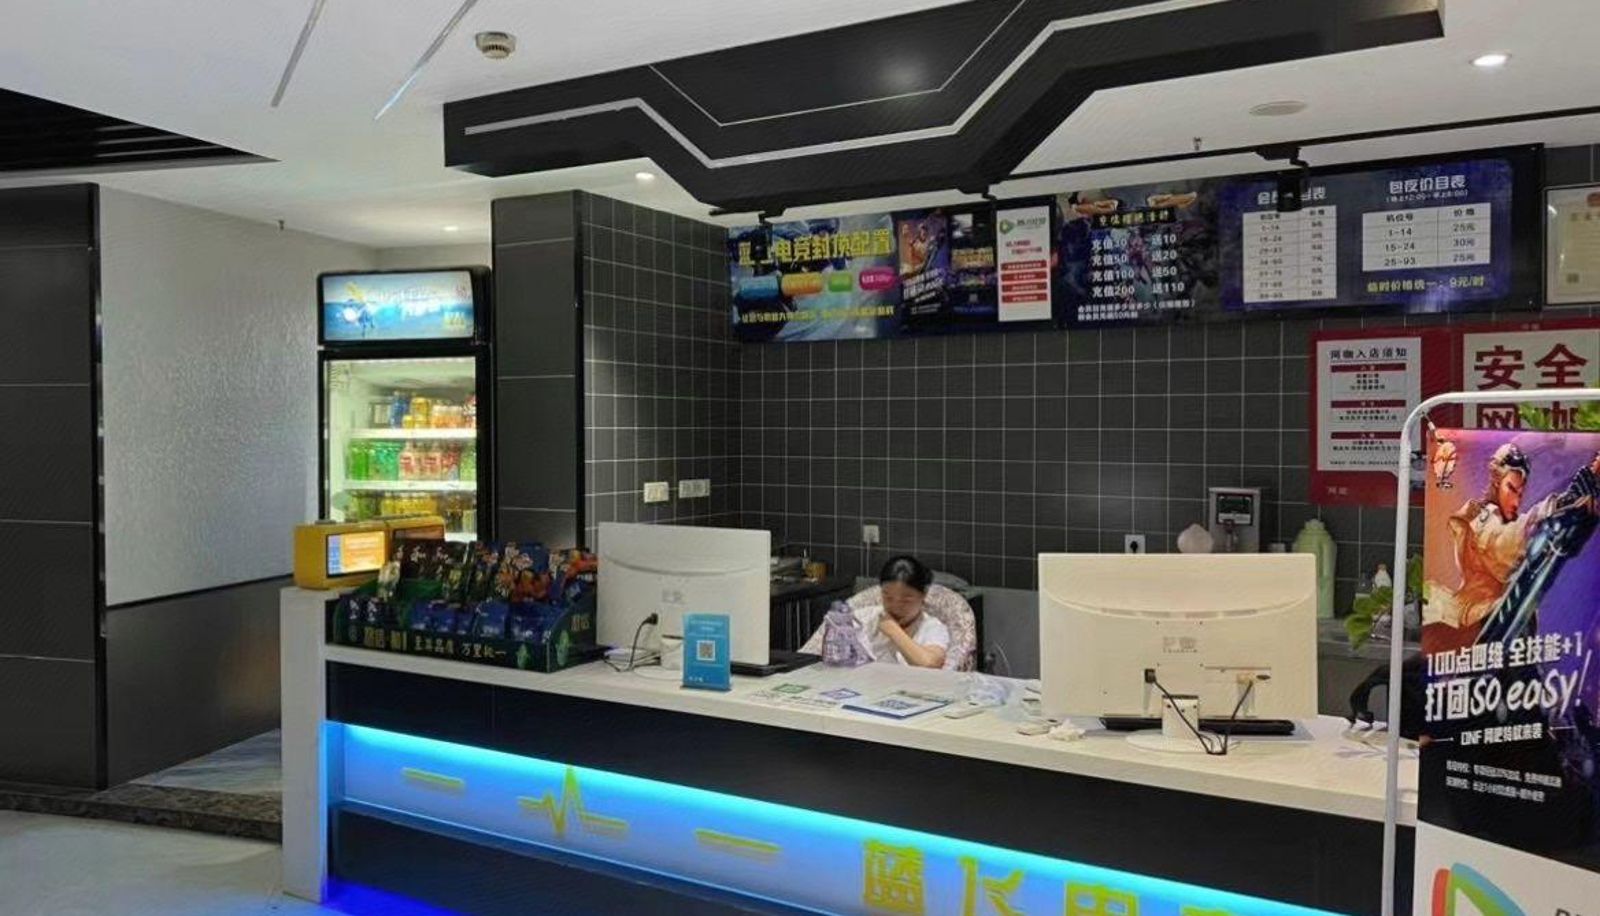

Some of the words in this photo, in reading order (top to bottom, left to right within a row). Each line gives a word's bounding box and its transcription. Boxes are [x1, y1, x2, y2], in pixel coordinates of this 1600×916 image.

[1389, 174, 1466, 195] 包夜价目表
[1386, 213, 1414, 223] 机位号
[1388, 227, 1413, 237] 1-14
[1453, 223, 1476, 233] 25元
[1152, 234, 1177, 246] 送10
[1453, 238, 1476, 248] 30元
[1385, 242, 1415, 252] 15-24
[1092, 254, 1128, 266] 充值50
[1152, 250, 1177, 262] 送20
[1384, 257, 1416, 267] 25-93
[1453, 253, 1475, 262] 25元
[1092, 270, 1135, 282] 充值100
[1152, 266, 1178, 278] 送50
[1092, 285, 1135, 298] 充值200
[1152, 282, 1185, 294] 送110
[1330, 347, 1408, 360] 网咖入店须知
[1474, 343, 1588, 391] 安全
[1426, 641, 1504, 677] 100点四维
[1508, 632, 1583, 668] 全技能+1
[1460, 730, 1483, 746] DNF
